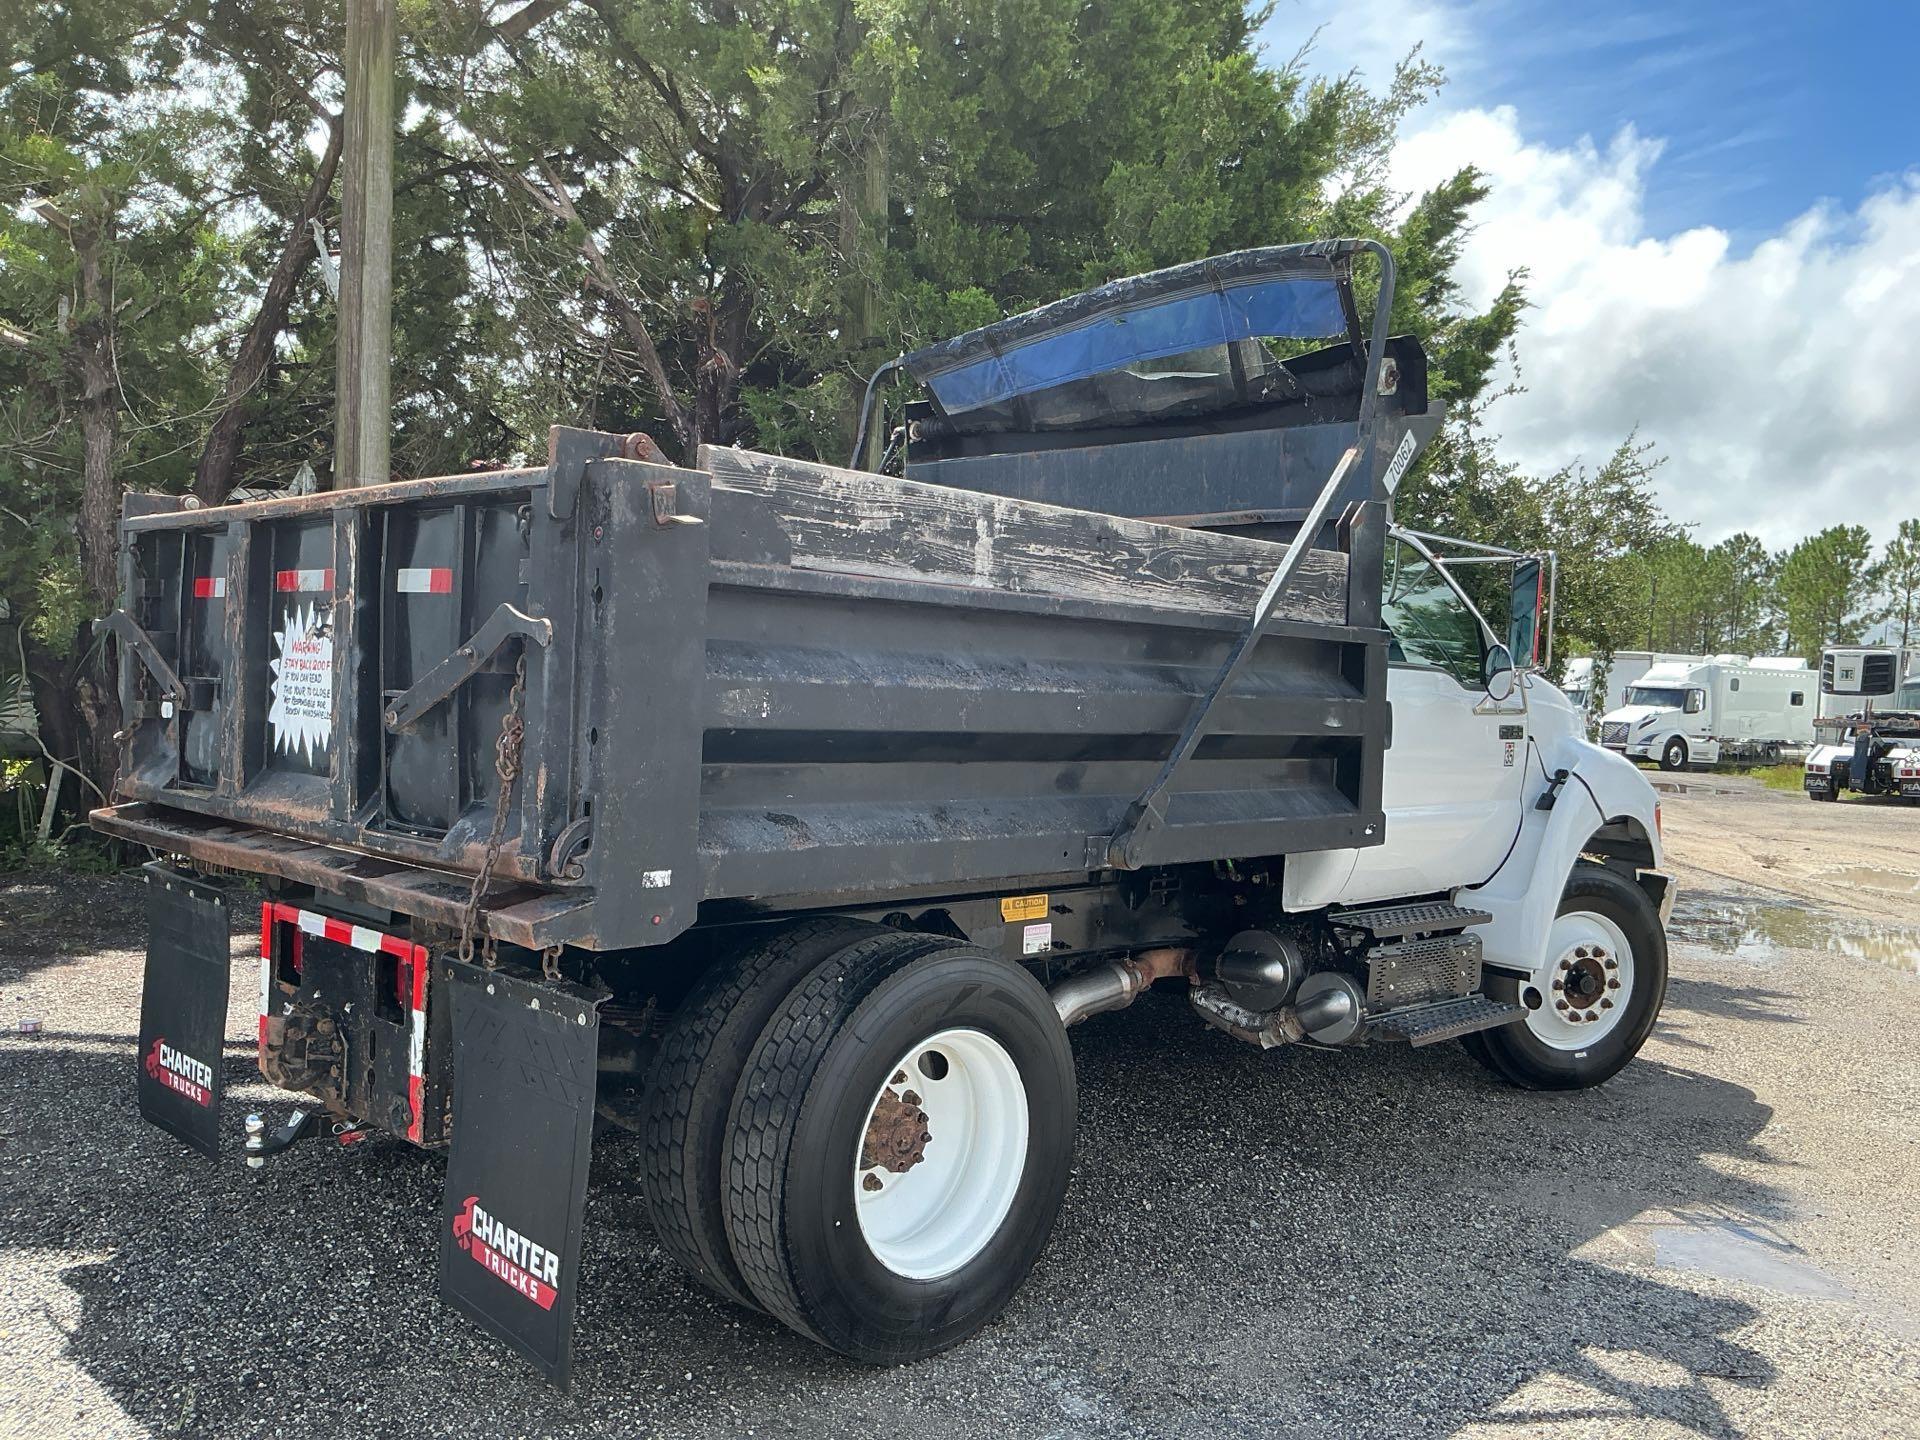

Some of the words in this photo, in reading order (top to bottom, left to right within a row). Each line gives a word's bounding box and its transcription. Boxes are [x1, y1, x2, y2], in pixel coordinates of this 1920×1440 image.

[1389, 439, 1412, 483] 70062
[284, 658, 298, 670] STAY
[313, 687, 330, 698] CLOSE
[1806, 777, 1828, 787] PEAK
[1903, 782, 1920, 791] PEA
[1016, 898, 1043, 908] CAUTION
[159, 1043, 212, 1091] CHARTER
[168, 1072, 202, 1102] TRUCKS
[472, 1204, 559, 1289] CHARTER
[484, 1248, 538, 1300] TRUCKS
